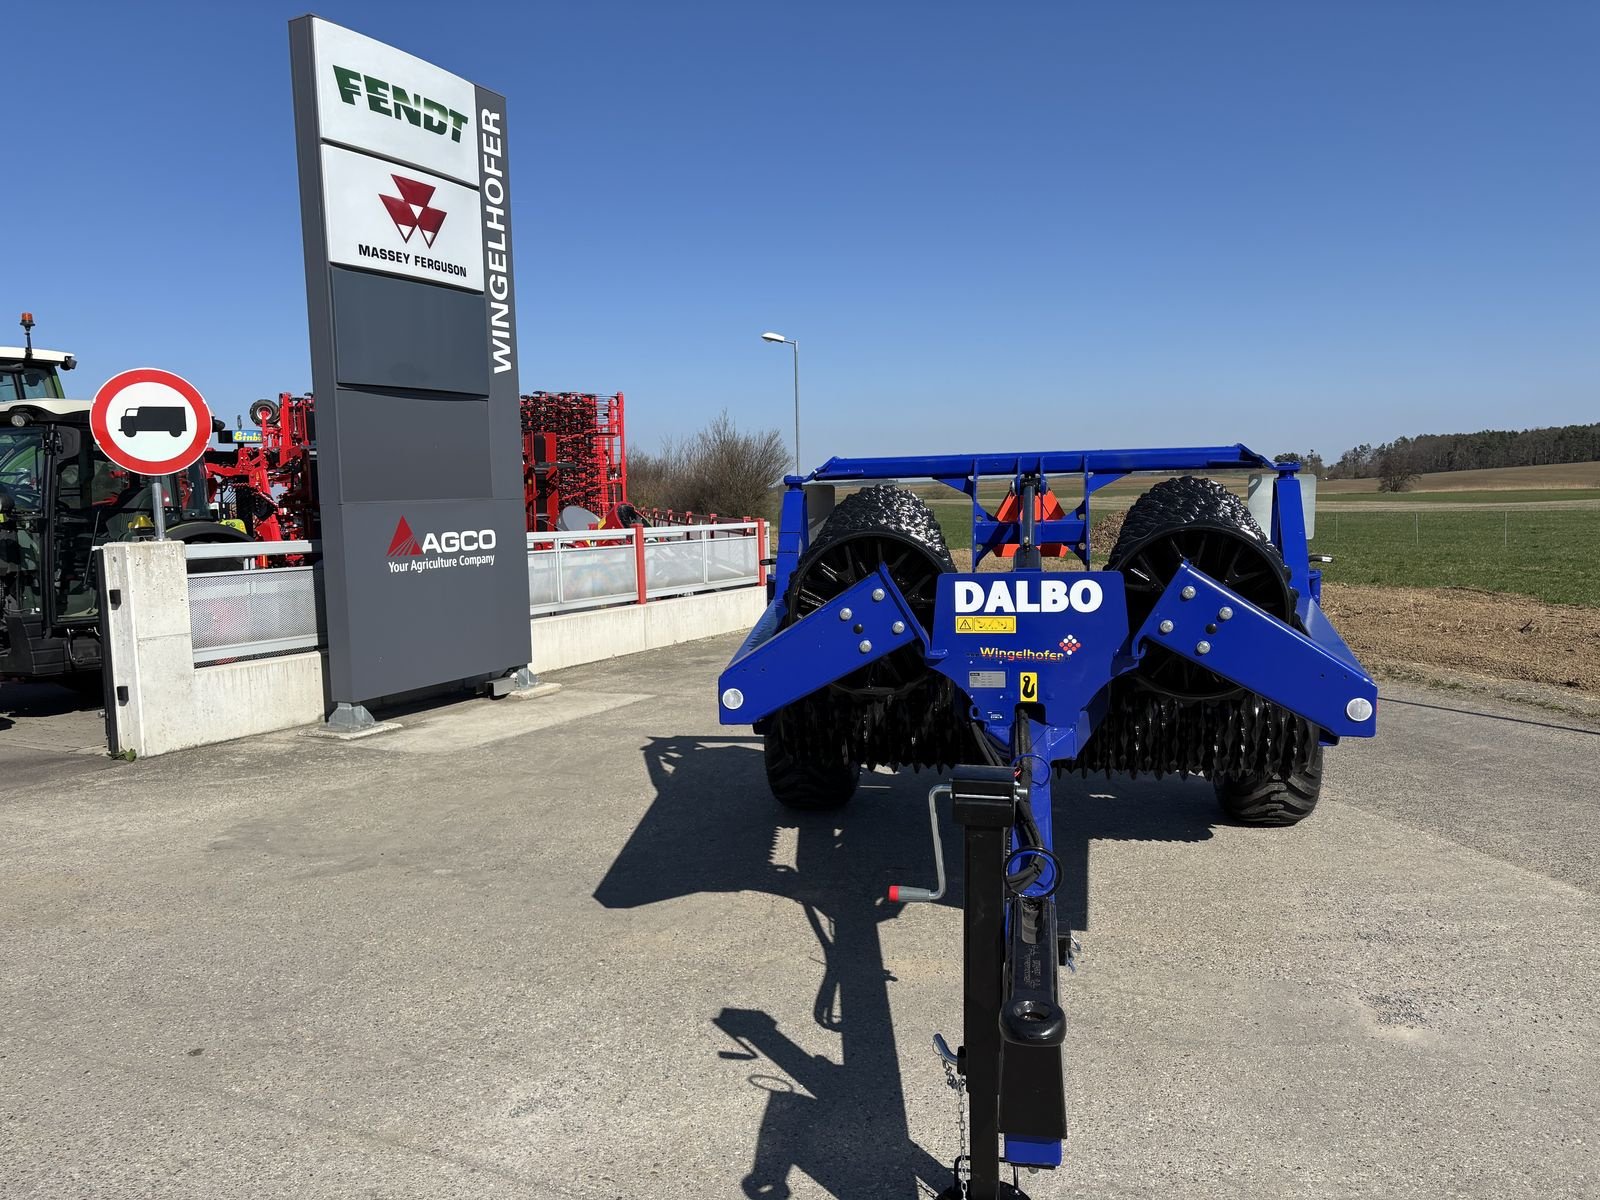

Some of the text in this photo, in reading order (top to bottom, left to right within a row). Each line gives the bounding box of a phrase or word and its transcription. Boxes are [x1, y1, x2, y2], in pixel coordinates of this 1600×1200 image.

[333, 65, 469, 143] FENDT
[481, 108, 512, 374] WINGELHOFER
[358, 244, 467, 277] MASSEY FERGUSON
[422, 529, 497, 554] AGCO
[388, 554, 495, 573] Your Agriculture Company
[954, 579, 1104, 613] DALBO
[979, 647, 1064, 661] Wingelhofer
